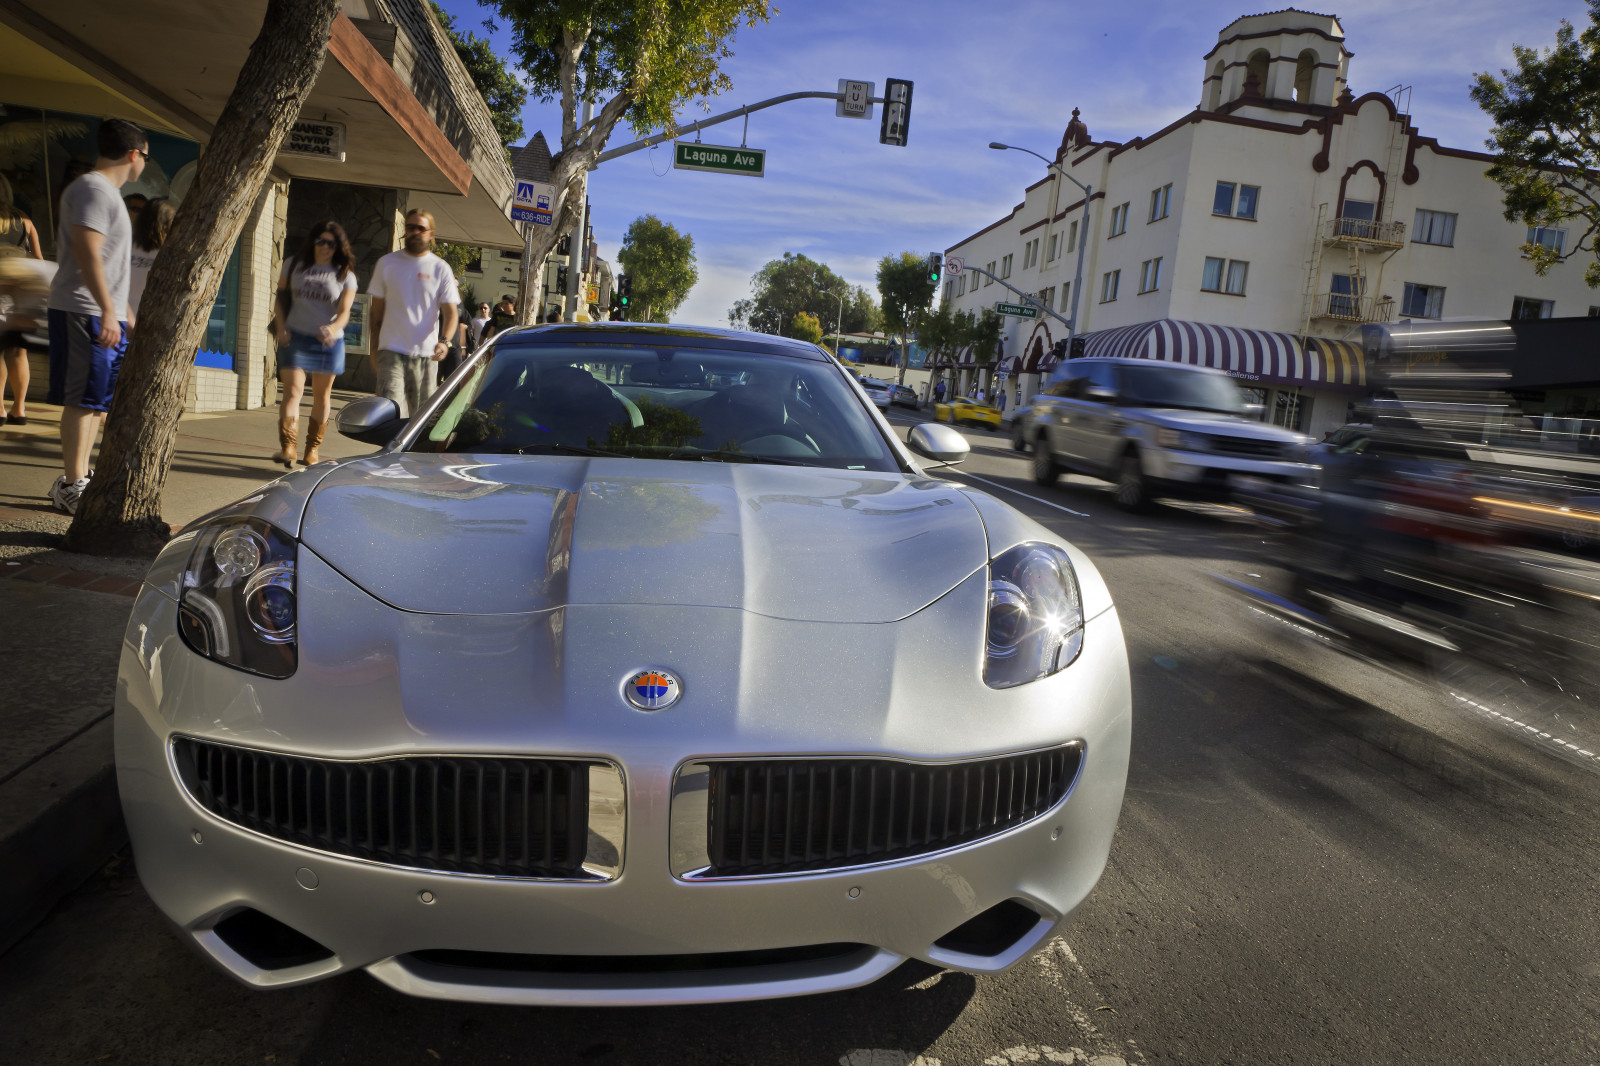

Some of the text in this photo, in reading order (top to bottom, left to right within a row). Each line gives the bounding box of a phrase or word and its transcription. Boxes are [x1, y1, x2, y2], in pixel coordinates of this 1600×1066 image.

[852, 92, 860, 102] U
[846, 102, 864, 111] TURN
[291, 133, 330, 146] SWIM
[289, 142, 331, 155] WEAR
[683, 147, 756, 166] Laguna Ave
[521, 211, 551, 224] 636-RIDE
[1000, 304, 1021, 314] Laguna
[1225, 369, 1260, 381] Galleries
[630, 670, 674, 685] FISKER
